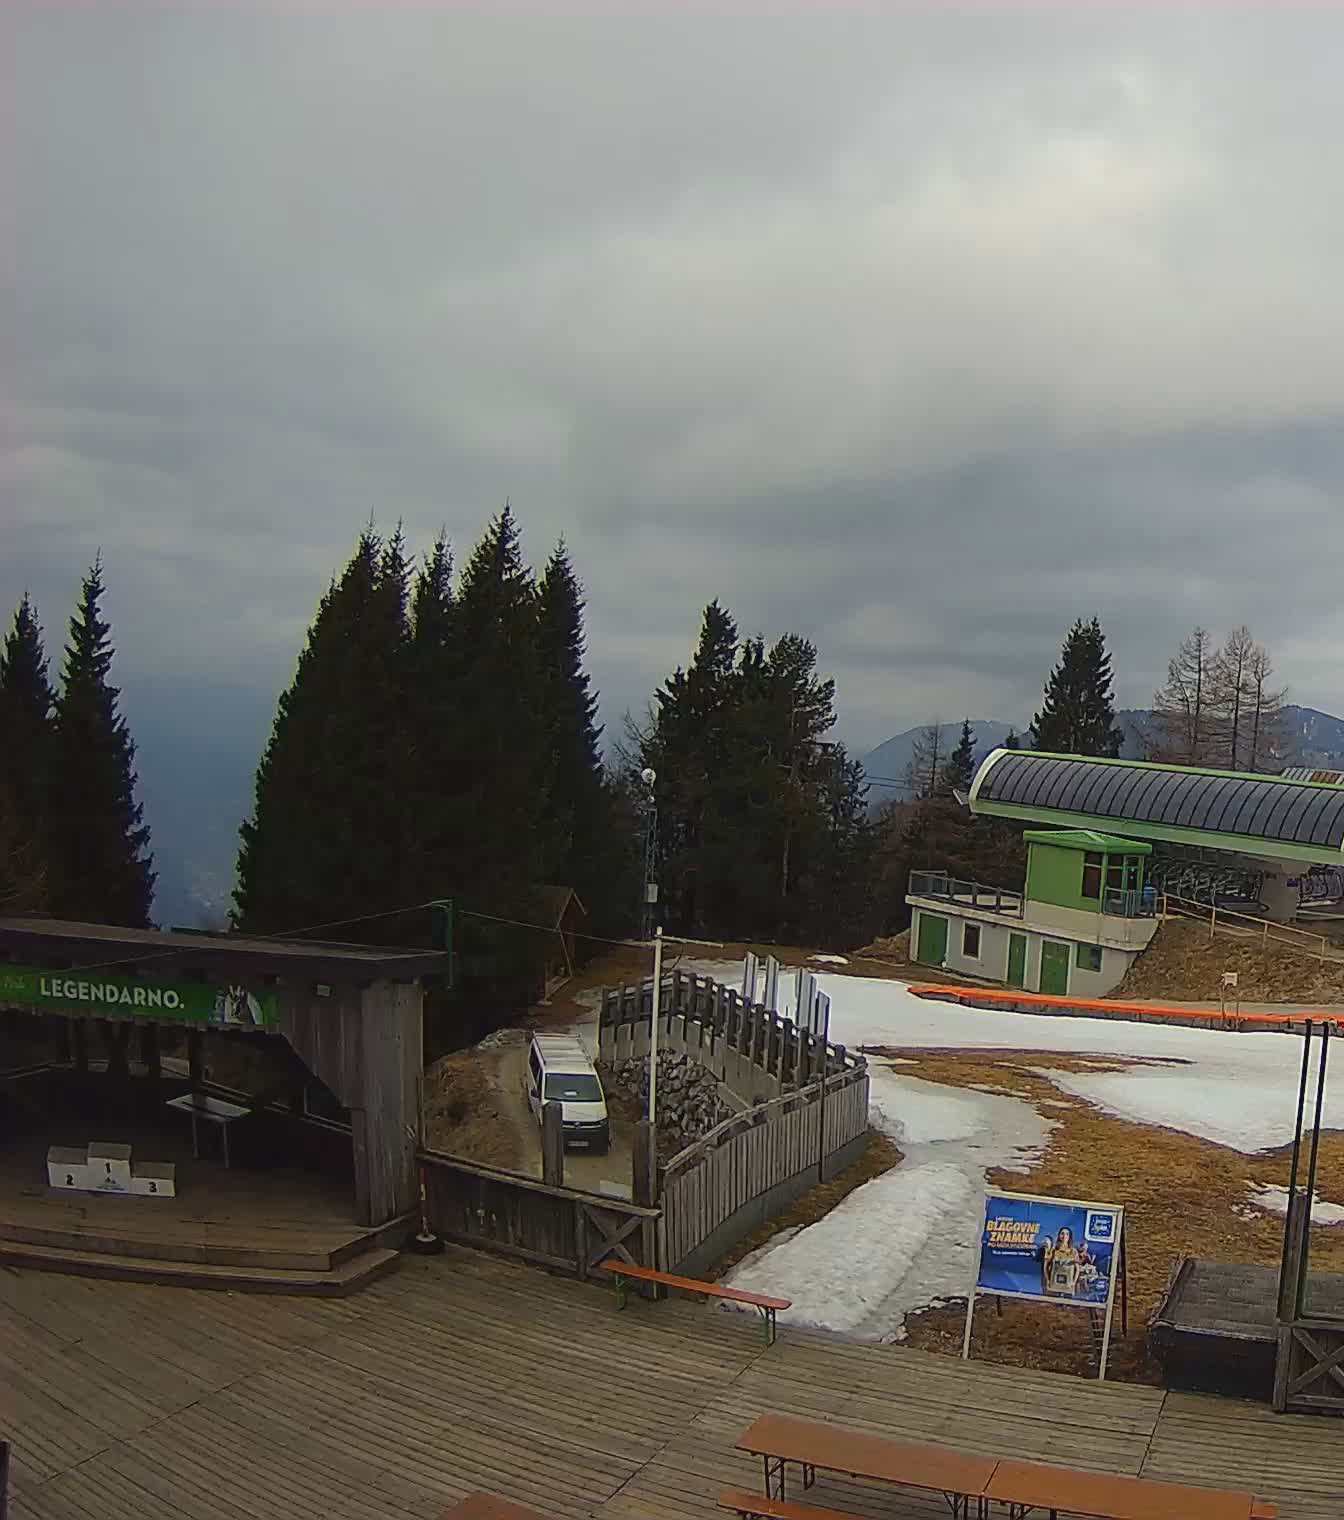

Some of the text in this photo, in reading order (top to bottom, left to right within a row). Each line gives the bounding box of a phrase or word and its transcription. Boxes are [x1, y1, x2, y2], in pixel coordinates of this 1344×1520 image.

[40, 977, 185, 1009] LEGENDARNO.
[105, 1162, 111, 1174] 1
[66, 1174, 74, 1186] 2
[149, 1181, 157, 1193] 3
[990, 1232, 1036, 1243] ZNAMKE
